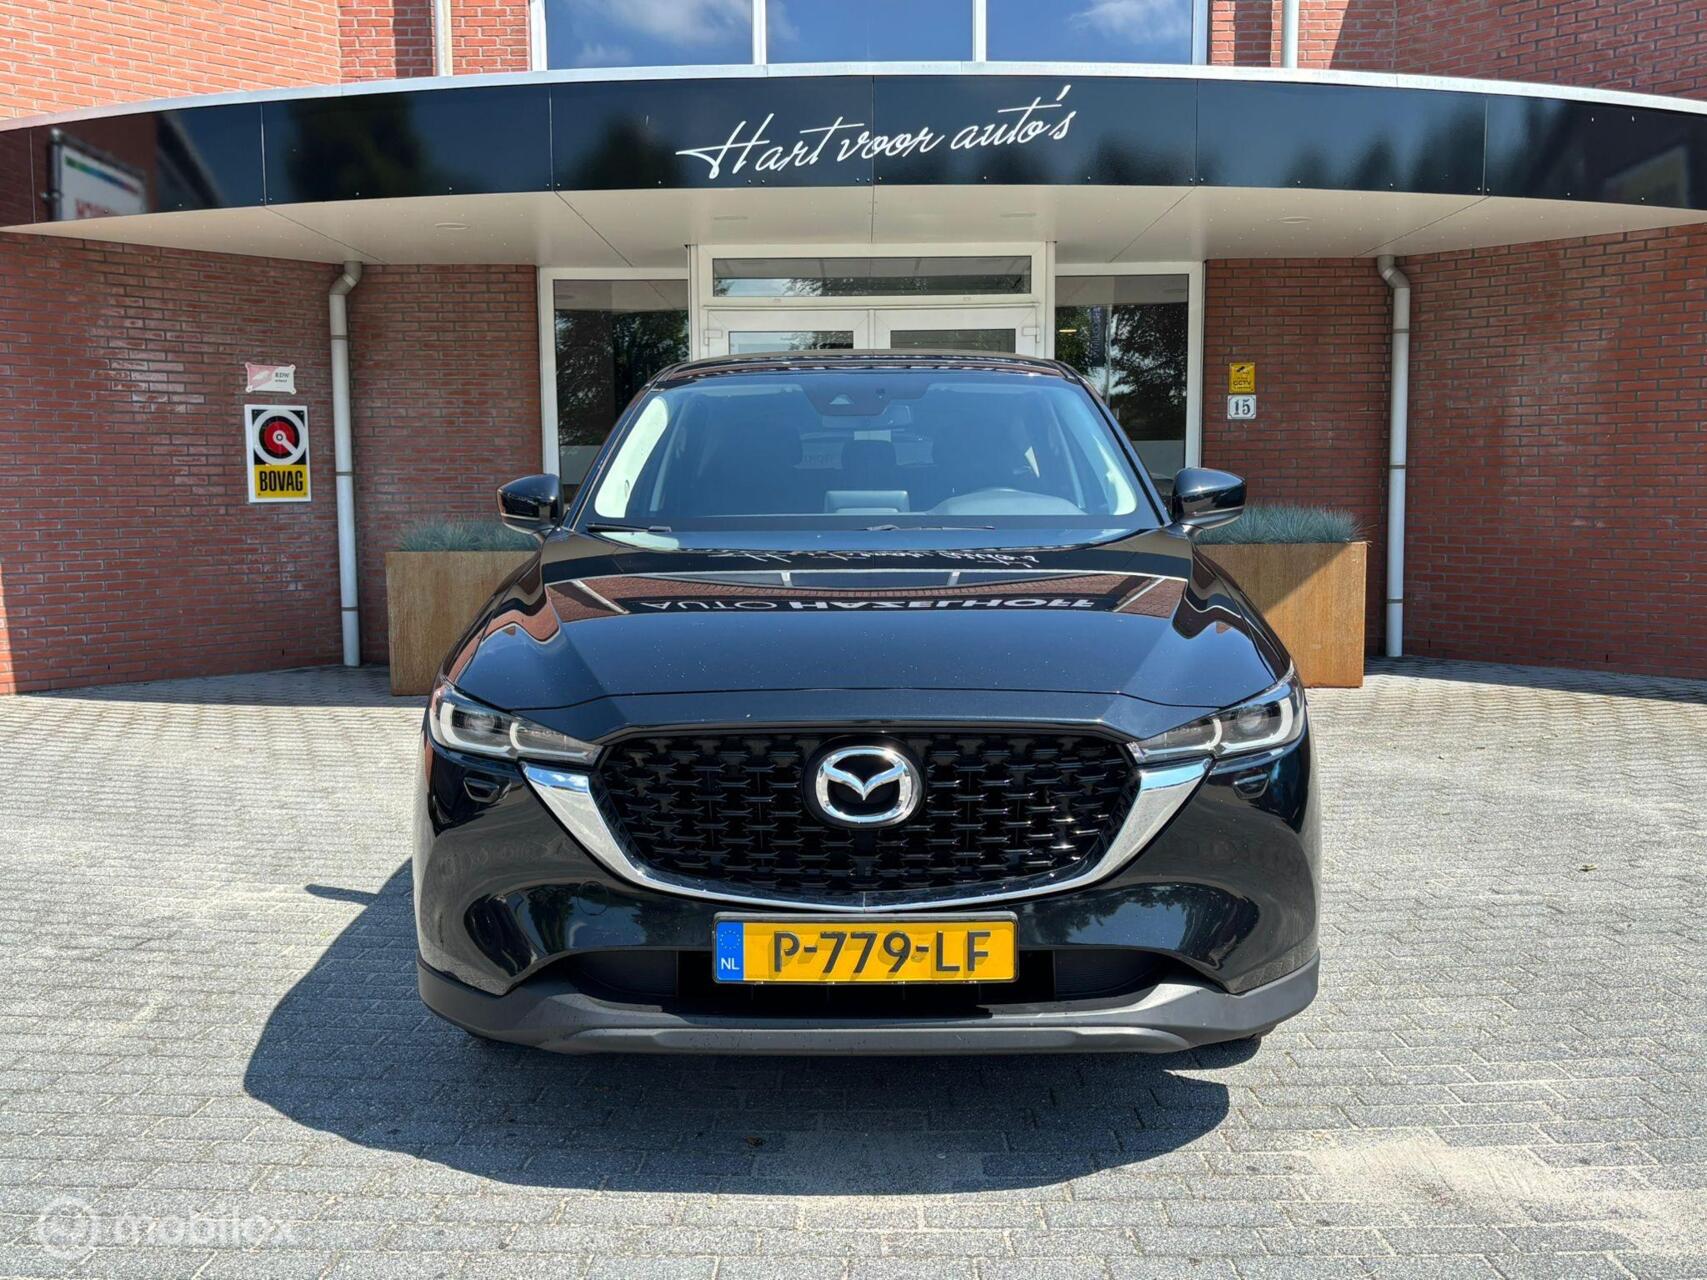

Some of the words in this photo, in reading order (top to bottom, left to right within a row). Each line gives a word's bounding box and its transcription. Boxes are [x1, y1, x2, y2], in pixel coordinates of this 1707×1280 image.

[675, 113, 864, 179] Hart
[836, 126, 945, 162] voor
[950, 85, 1077, 150] auto's
[1233, 399, 1251, 415] 15
[259, 470, 303, 491] BOVAG
[773, 930, 991, 974] P-779-LF
[720, 957, 740, 970] NL
